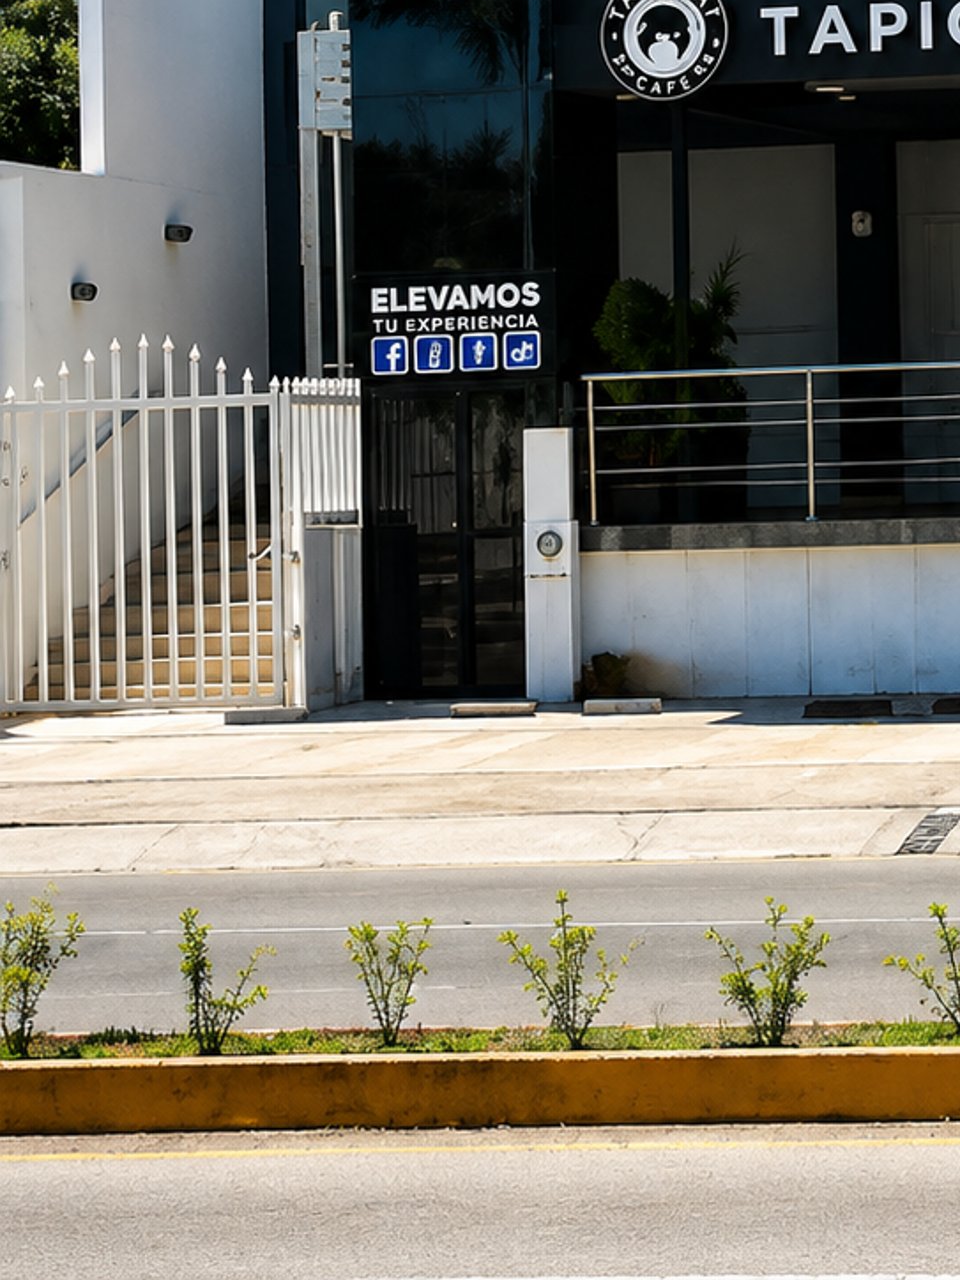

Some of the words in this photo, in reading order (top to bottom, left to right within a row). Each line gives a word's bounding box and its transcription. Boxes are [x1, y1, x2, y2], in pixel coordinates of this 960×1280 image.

[371, 282, 541, 313] ELEVAMOS
[373, 319, 398, 333] TU
[405, 314, 539, 332] EXPERIENCIA
